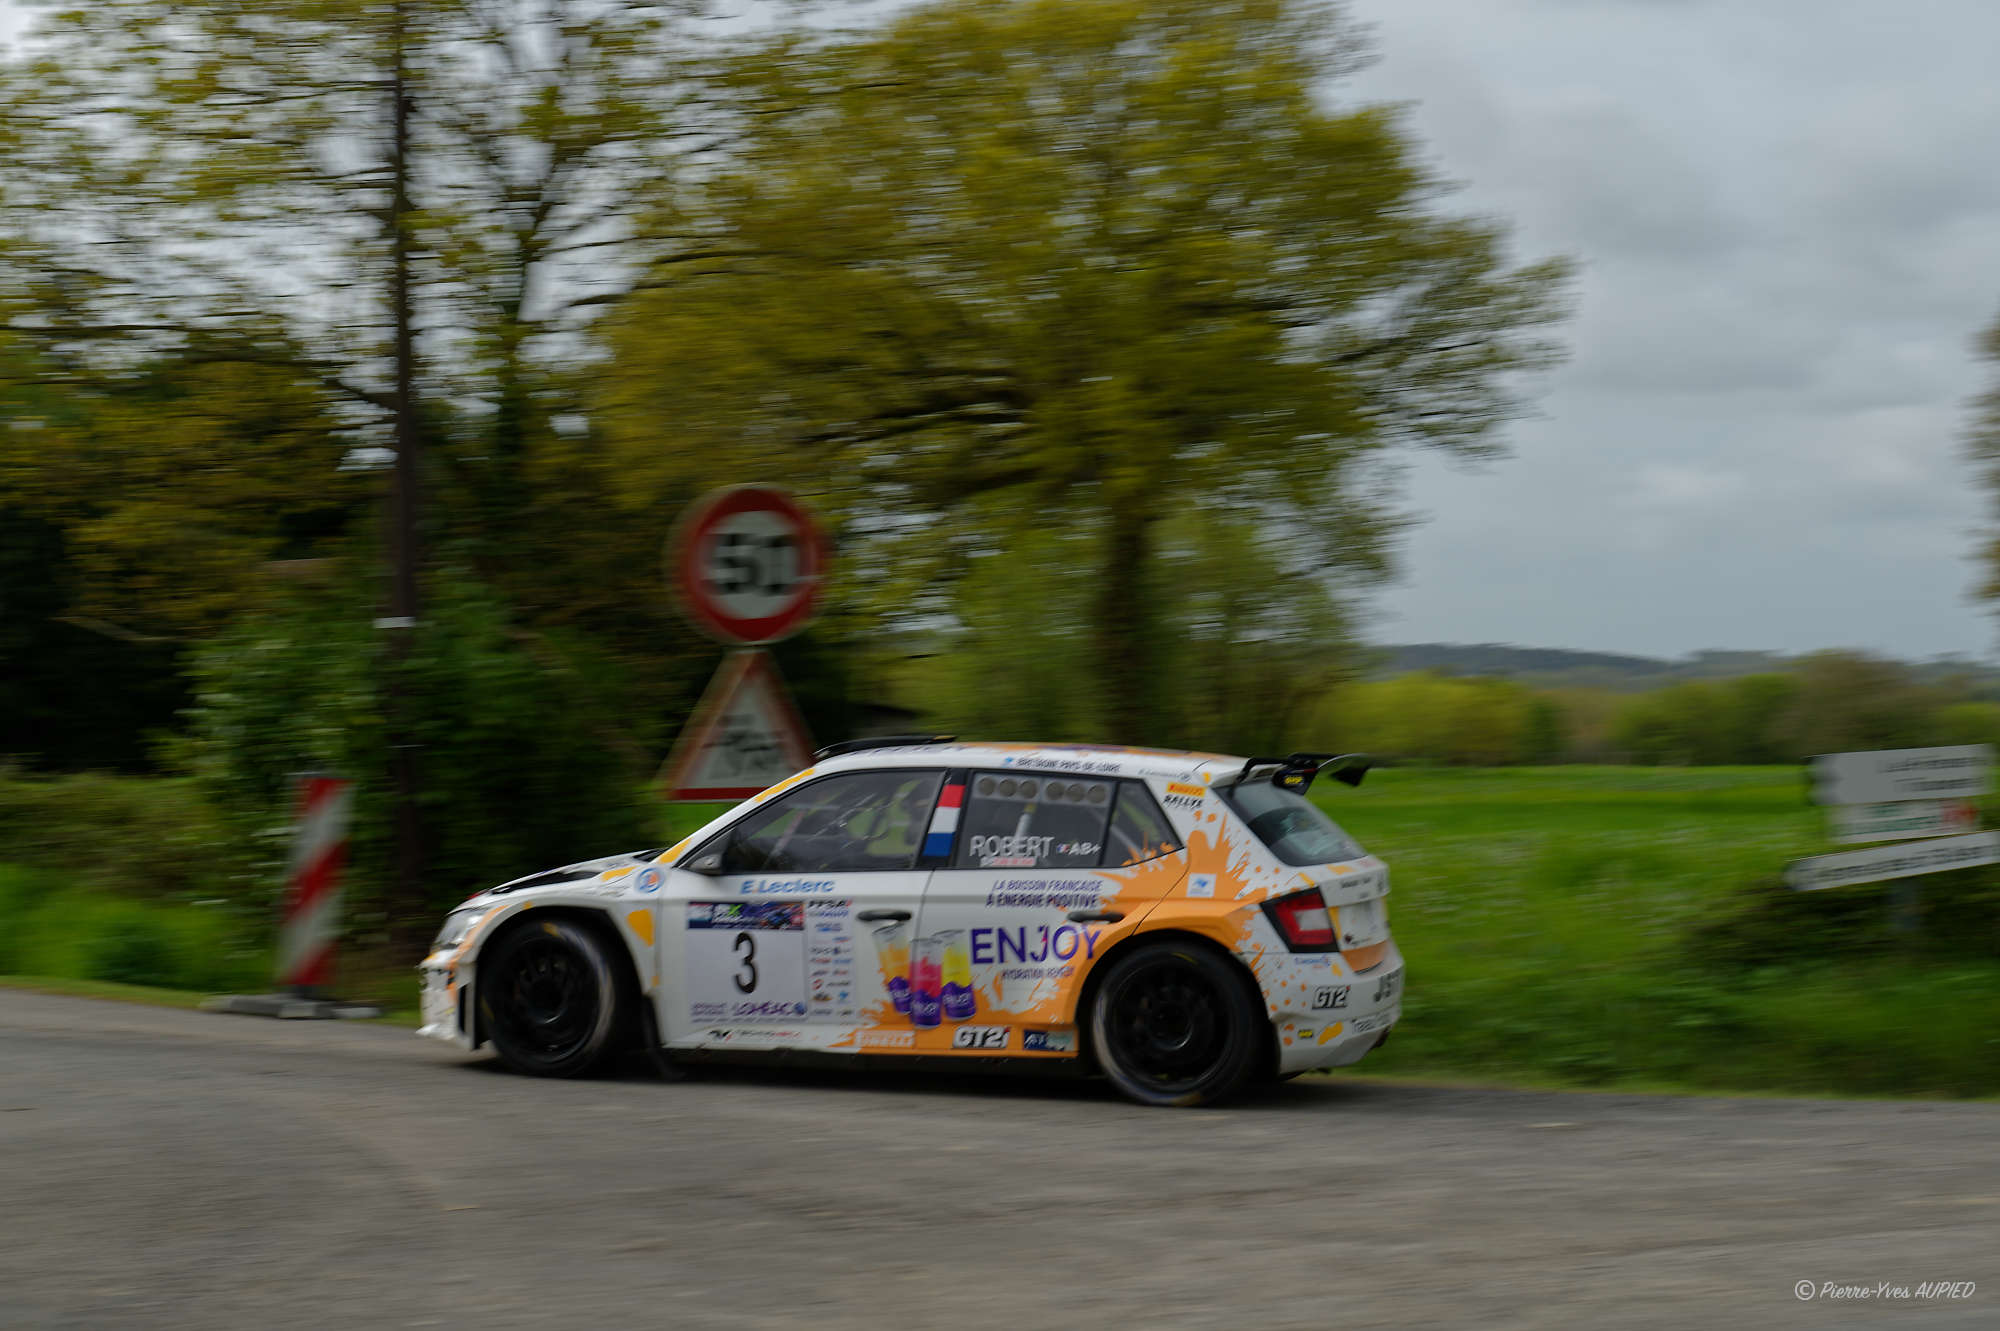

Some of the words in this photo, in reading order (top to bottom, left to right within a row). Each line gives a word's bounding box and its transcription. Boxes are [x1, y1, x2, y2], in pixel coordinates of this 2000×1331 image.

[969, 835, 1055, 858] ROBERT
[1007, 880, 1047, 891] BOISSON
[1045, 894, 1099, 907] POSITIVE
[971, 924, 1102, 964] ENJOY
[733, 931, 757, 994] 3
